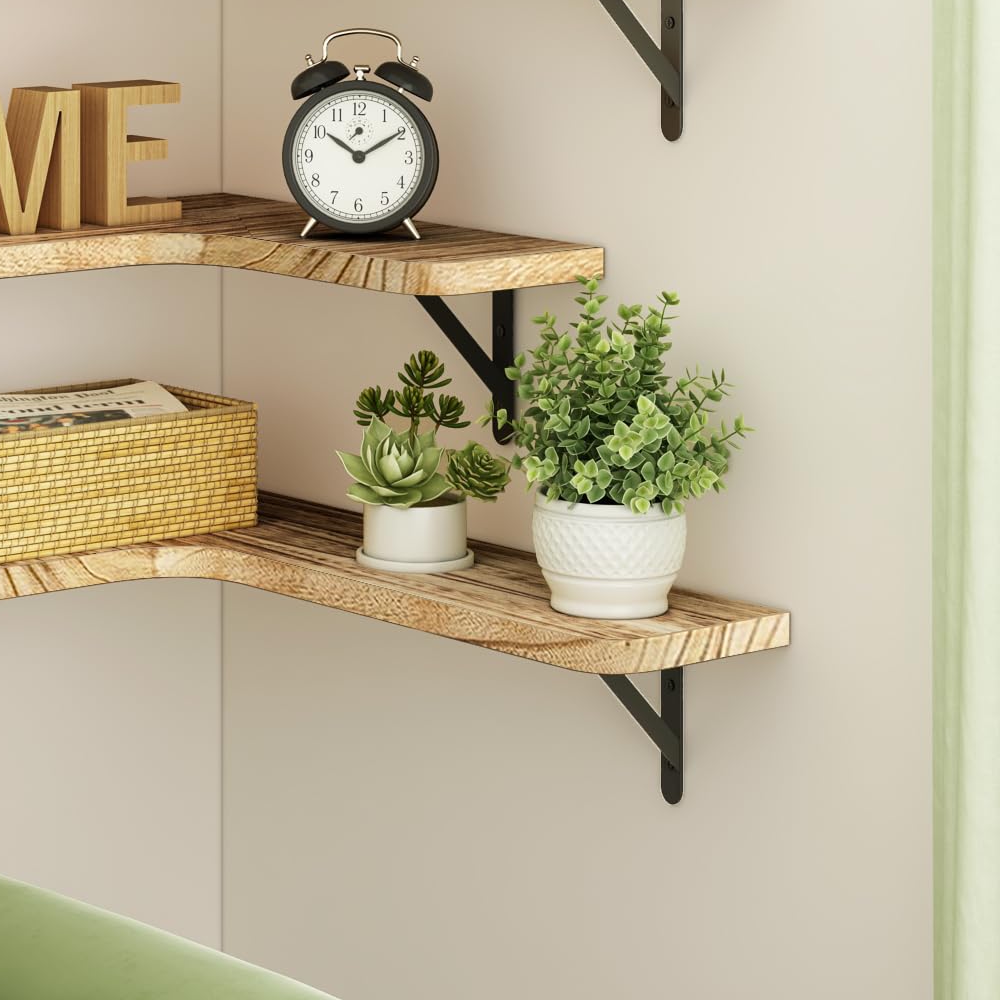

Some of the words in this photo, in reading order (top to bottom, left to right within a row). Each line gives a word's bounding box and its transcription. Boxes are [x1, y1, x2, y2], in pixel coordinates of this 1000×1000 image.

[331, 108, 342, 122] 11
[353, 102, 367, 116] 12
[382, 109, 387, 122] 1
[314, 125, 326, 139] 10
[397, 126, 406, 140] 2
[304, 149, 313, 163] 9
[404, 151, 413, 165] 3
[311, 173, 320, 187] 8
[396, 175, 405, 189] 4
[330, 190, 339, 205] 7
[380, 192, 389, 206] 5
[354, 198, 363, 212] 6
[74, 389, 115, 399] Post
[72, 399, 145, 409] term
